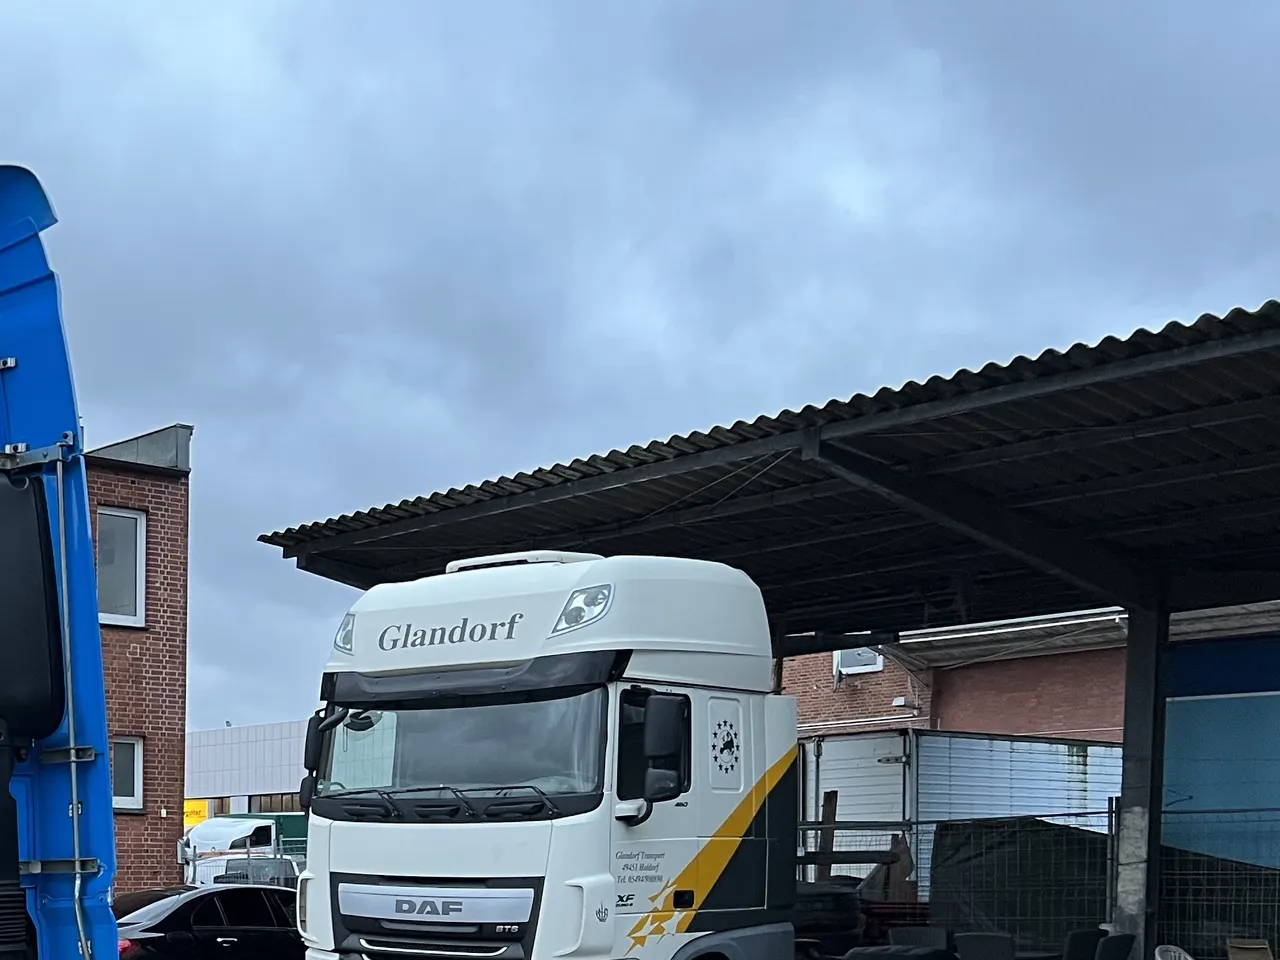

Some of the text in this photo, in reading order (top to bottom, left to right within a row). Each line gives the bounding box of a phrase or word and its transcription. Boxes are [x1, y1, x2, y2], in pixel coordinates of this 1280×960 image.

[378, 612, 524, 652] Glandorf
[616, 894, 636, 903] XF
[395, 899, 463, 916] DAF
